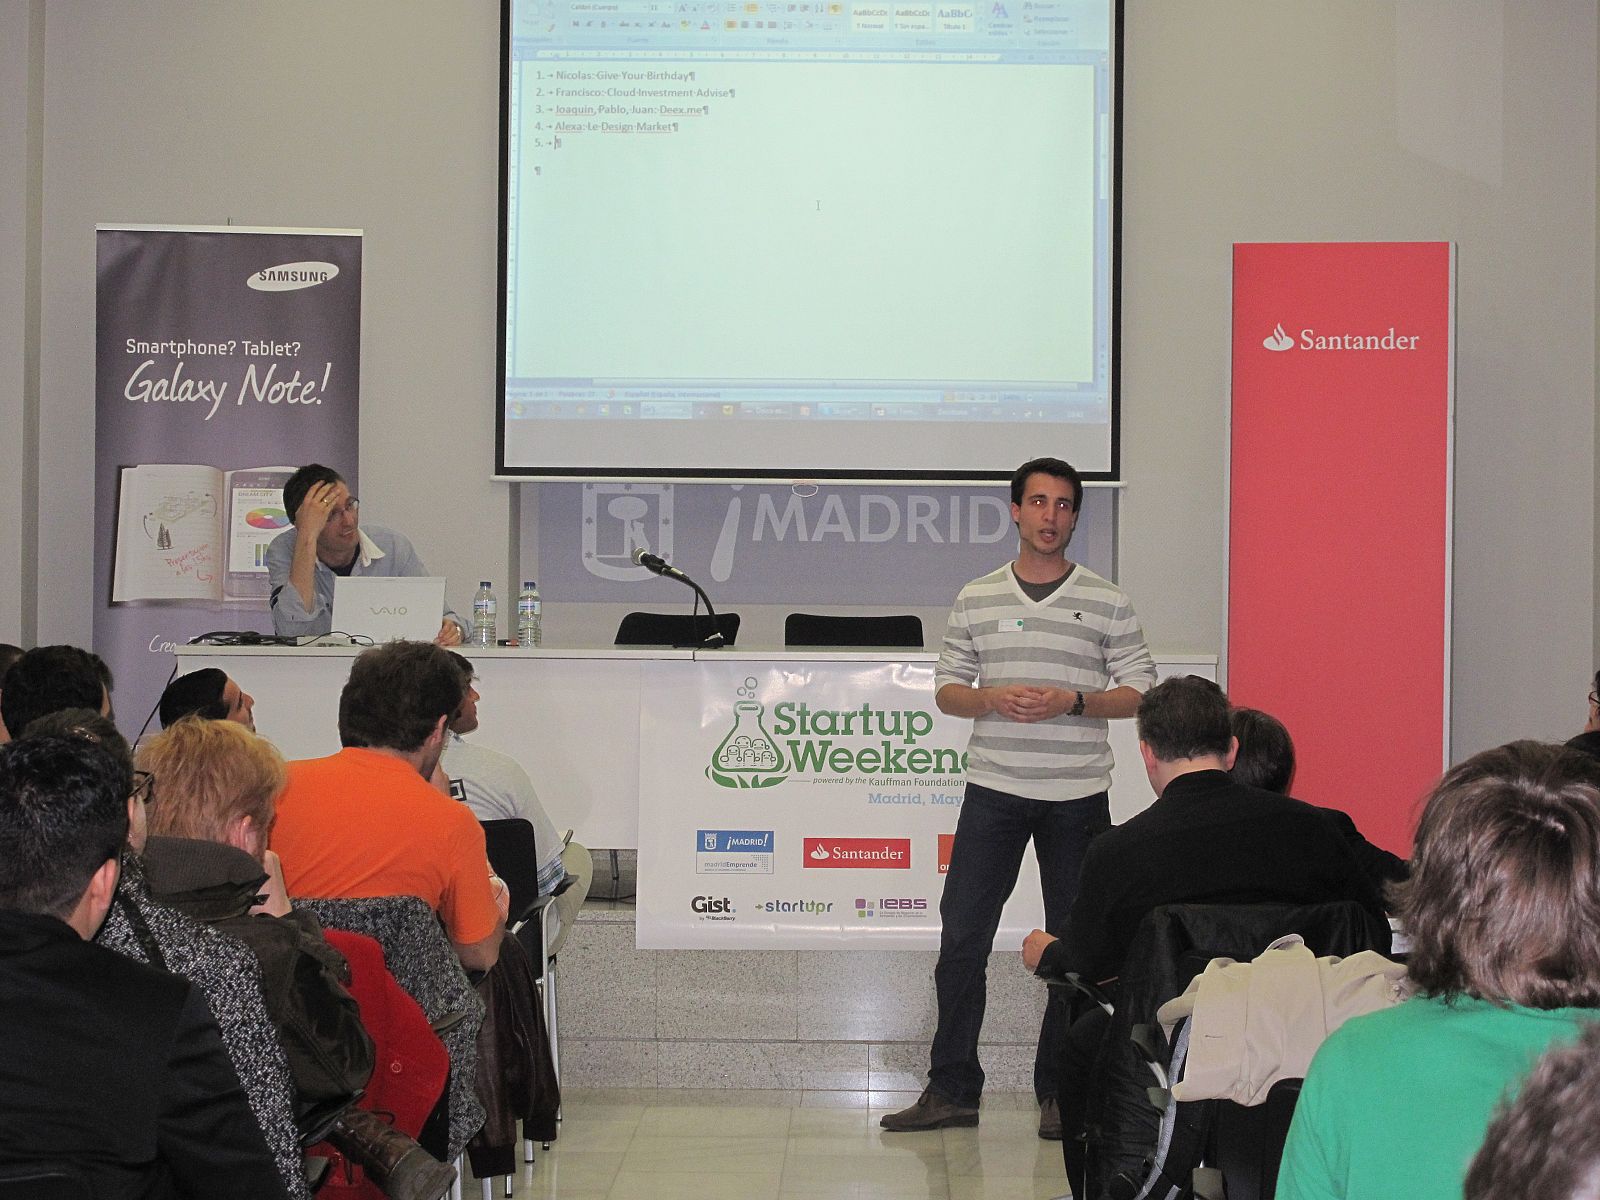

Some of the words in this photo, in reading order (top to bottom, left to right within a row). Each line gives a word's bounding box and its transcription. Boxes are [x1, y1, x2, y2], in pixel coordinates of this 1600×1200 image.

[555, 70, 596, 81] Nicolas:
[596, 70, 619, 81] Give
[621, 70, 645, 81] Your
[606, 87, 636, 98] Cloud
[638, 87, 694, 98] Investment
[587, 121, 600, 131] Le
[600, 121, 634, 134] Design
[636, 121, 672, 132] Market
[258, 270, 328, 283] SAMSUNG
[1300, 327, 1420, 351] Santander
[126, 338, 237, 358] Smartphone?
[242, 340, 301, 356] Tablet?
[123, 359, 228, 421] Galaxy
[237, 362, 332, 406] Note!
[369, 606, 408, 616] VAIO
[773, 701, 934, 744] Startup
[812, 776, 844, 786] powered
[845, 776, 854, 786] by
[854, 776, 867, 785] the
[868, 777, 912, 787] Kauffman
[914, 777, 965, 787] Foundation
[867, 793, 926, 806] Madrid,
[832, 846, 904, 860] Santander
